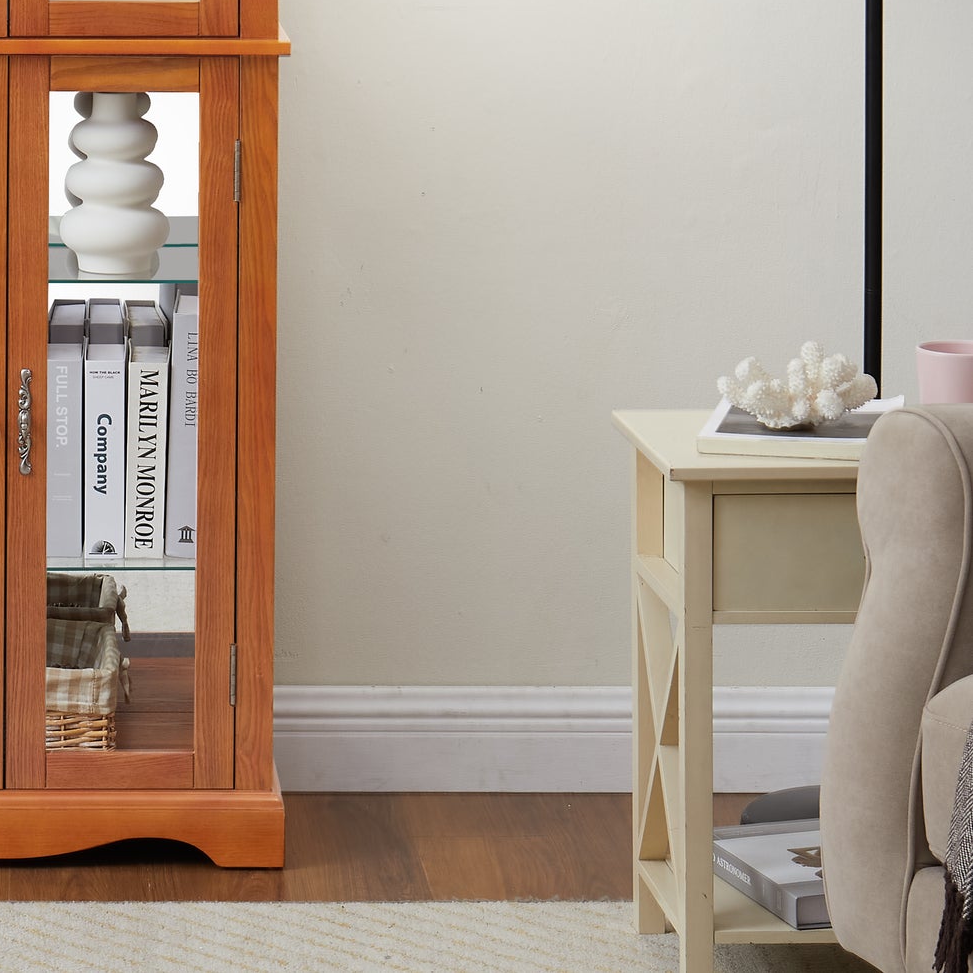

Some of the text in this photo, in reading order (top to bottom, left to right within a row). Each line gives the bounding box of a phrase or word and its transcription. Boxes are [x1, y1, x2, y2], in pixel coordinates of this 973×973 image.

[55, 365, 68, 448] FULL STOP.
[184, 332, 198, 428] LINA BO BARDI
[93, 413, 113, 495] Company
[134, 369, 159, 550] MARILYN MONROE
